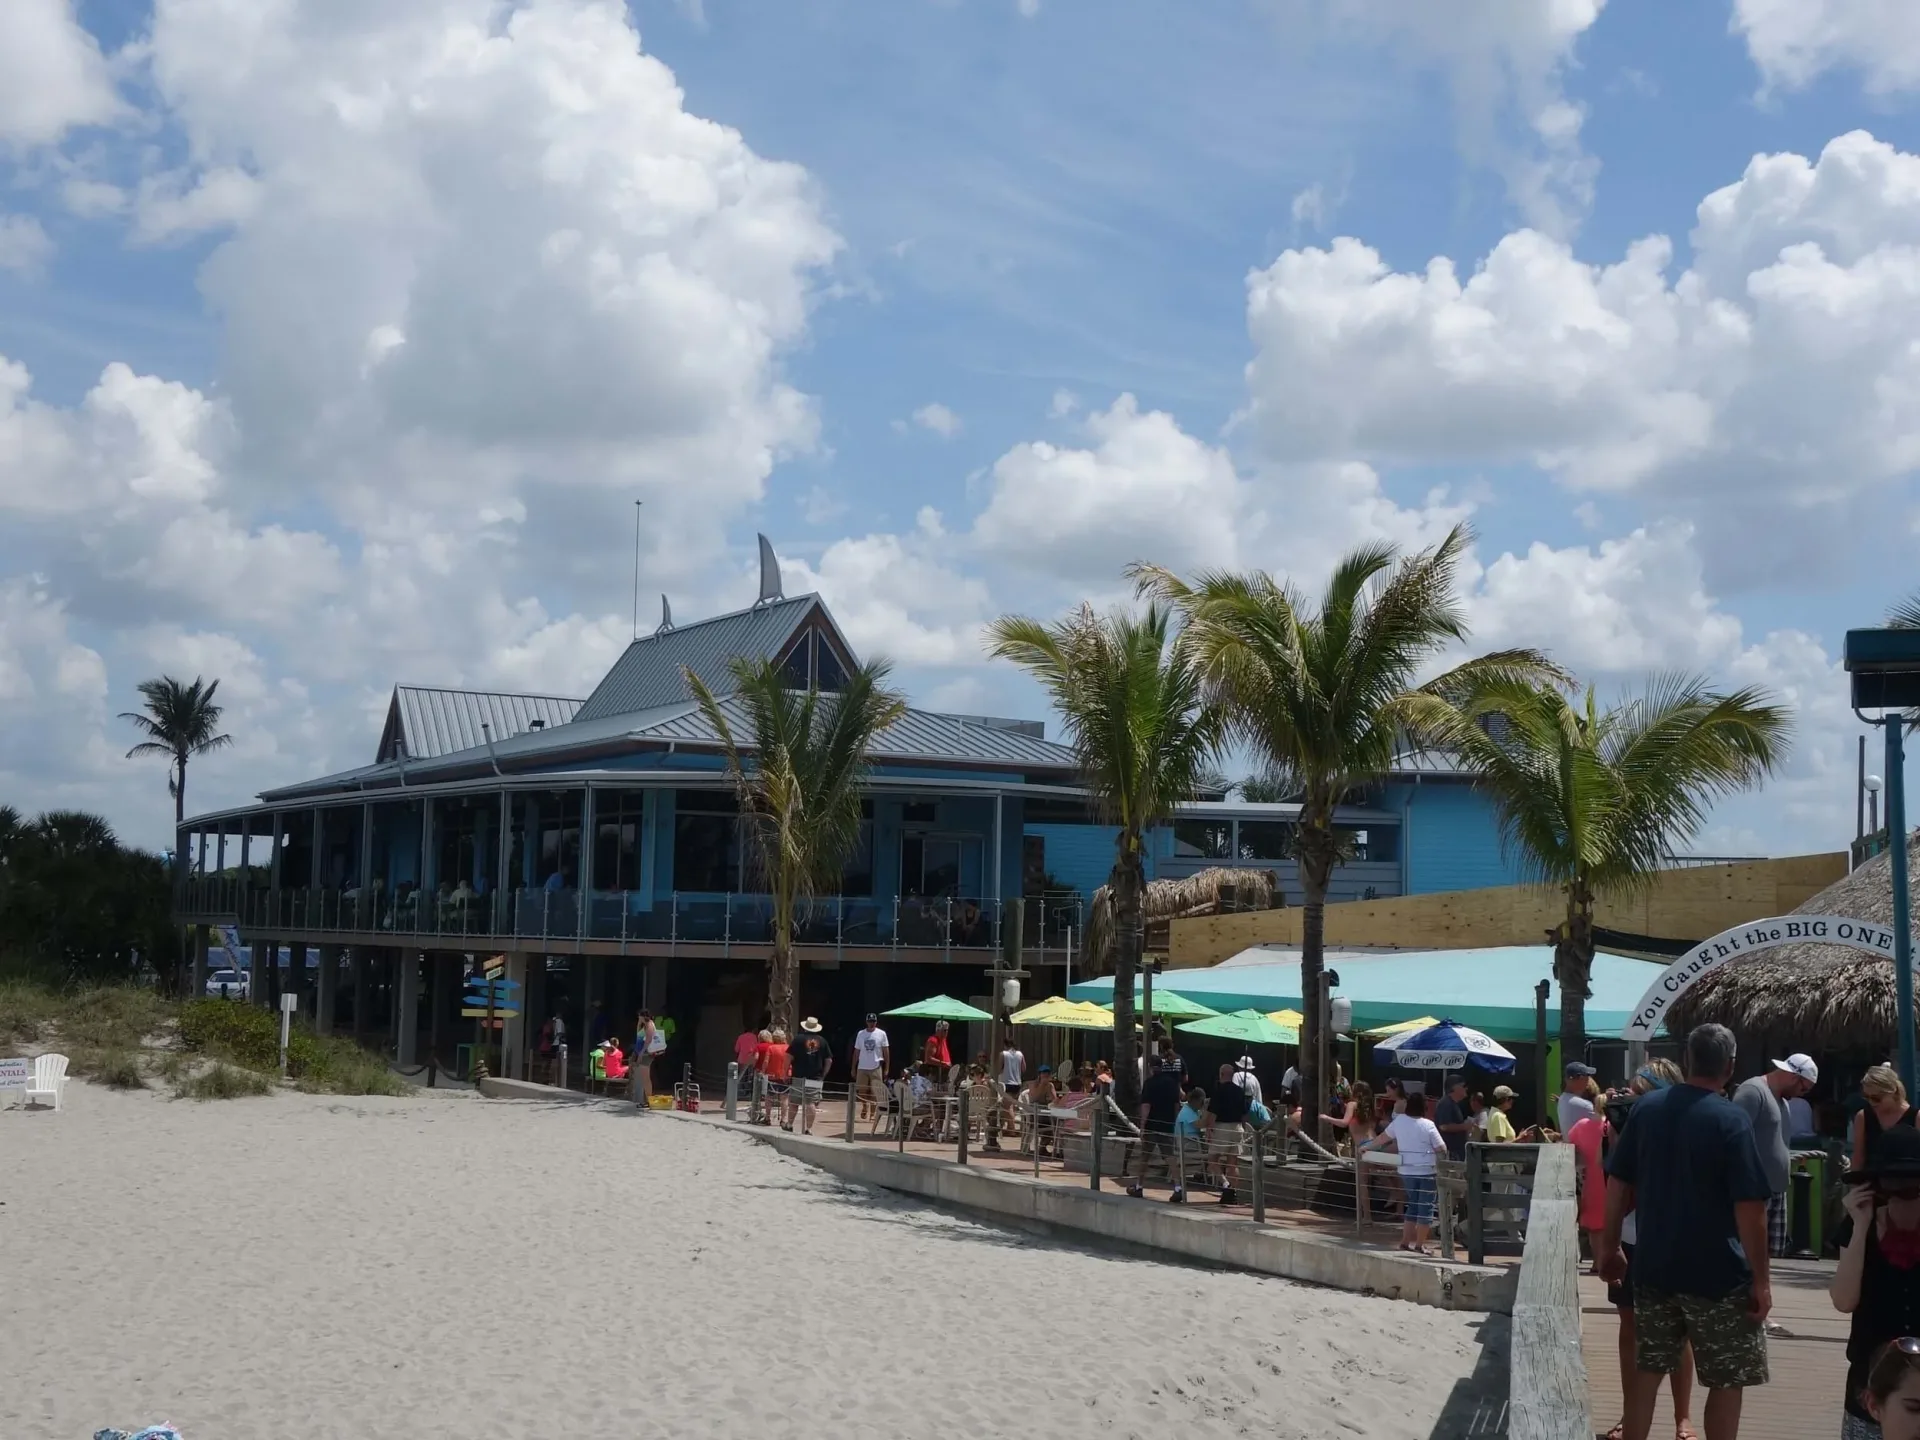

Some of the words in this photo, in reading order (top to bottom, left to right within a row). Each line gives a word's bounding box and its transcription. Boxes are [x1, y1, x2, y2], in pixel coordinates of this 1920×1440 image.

[1632, 998, 1665, 1032] You
[1664, 938, 1740, 992] Caught
[1746, 928, 1781, 945] the
[1786, 921, 1829, 938] BIG
[1837, 922, 1893, 950] ONE
